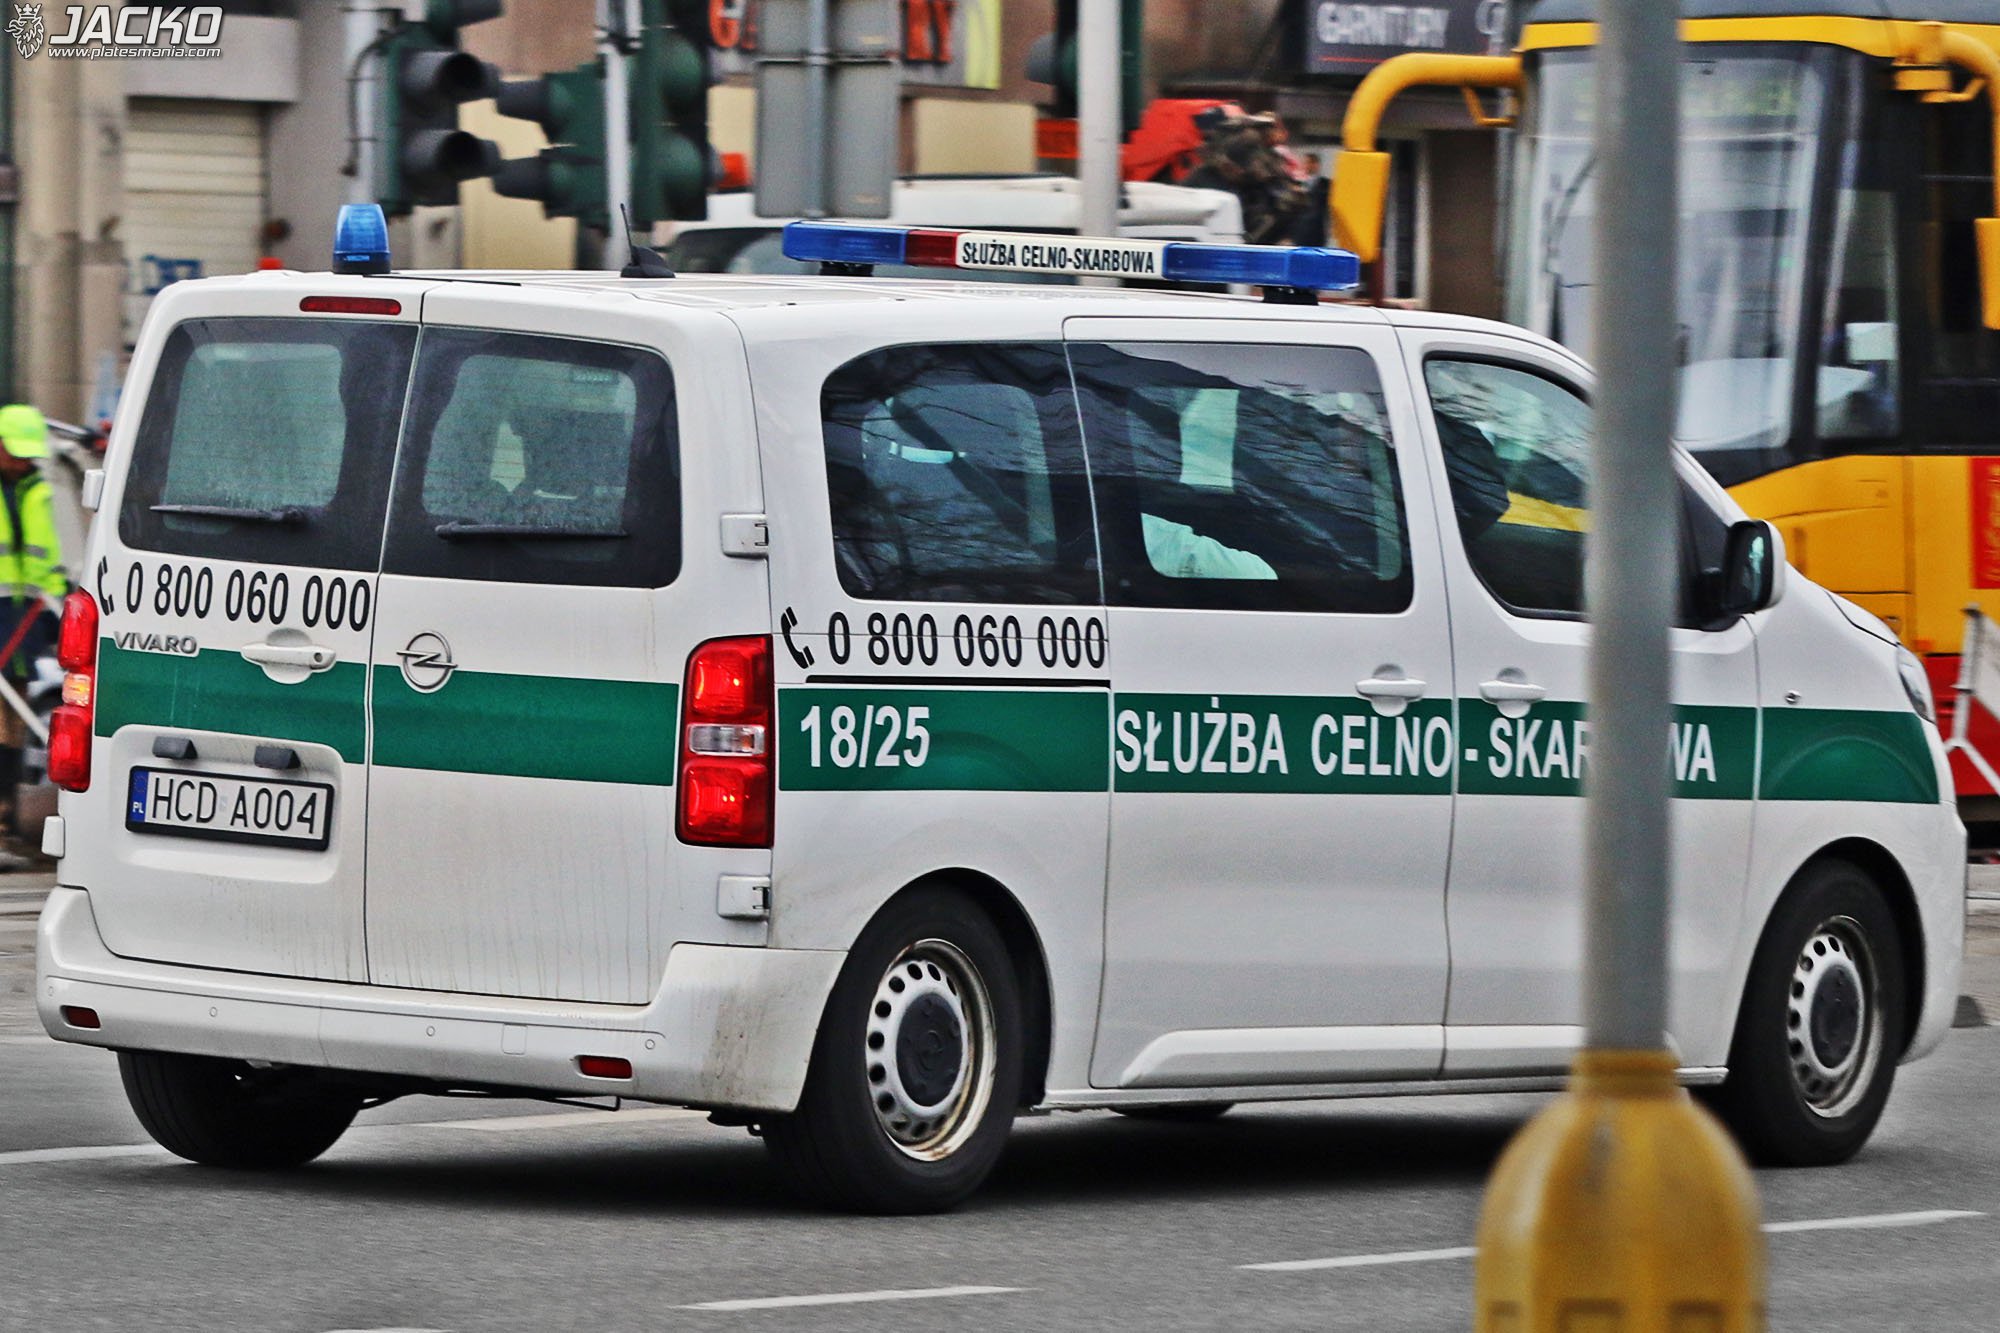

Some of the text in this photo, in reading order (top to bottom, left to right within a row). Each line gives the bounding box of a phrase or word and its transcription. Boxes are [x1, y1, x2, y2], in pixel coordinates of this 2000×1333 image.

[963, 239, 1154, 274] SŁUŻBA CELNO-SKARBOWA
[126, 562, 370, 631] 0 800 060 000
[114, 631, 198, 655] VIVARO
[828, 612, 1105, 668] 0 800 060 000
[800, 704, 930, 768] 18/25
[1115, 696, 1289, 775] SŁUŻBA
[1311, 713, 1453, 778] CELNO
[1488, 717, 1717, 782] SKARWA
[132, 801, 144, 814] PL
[152, 777, 317, 834] HCD A004
